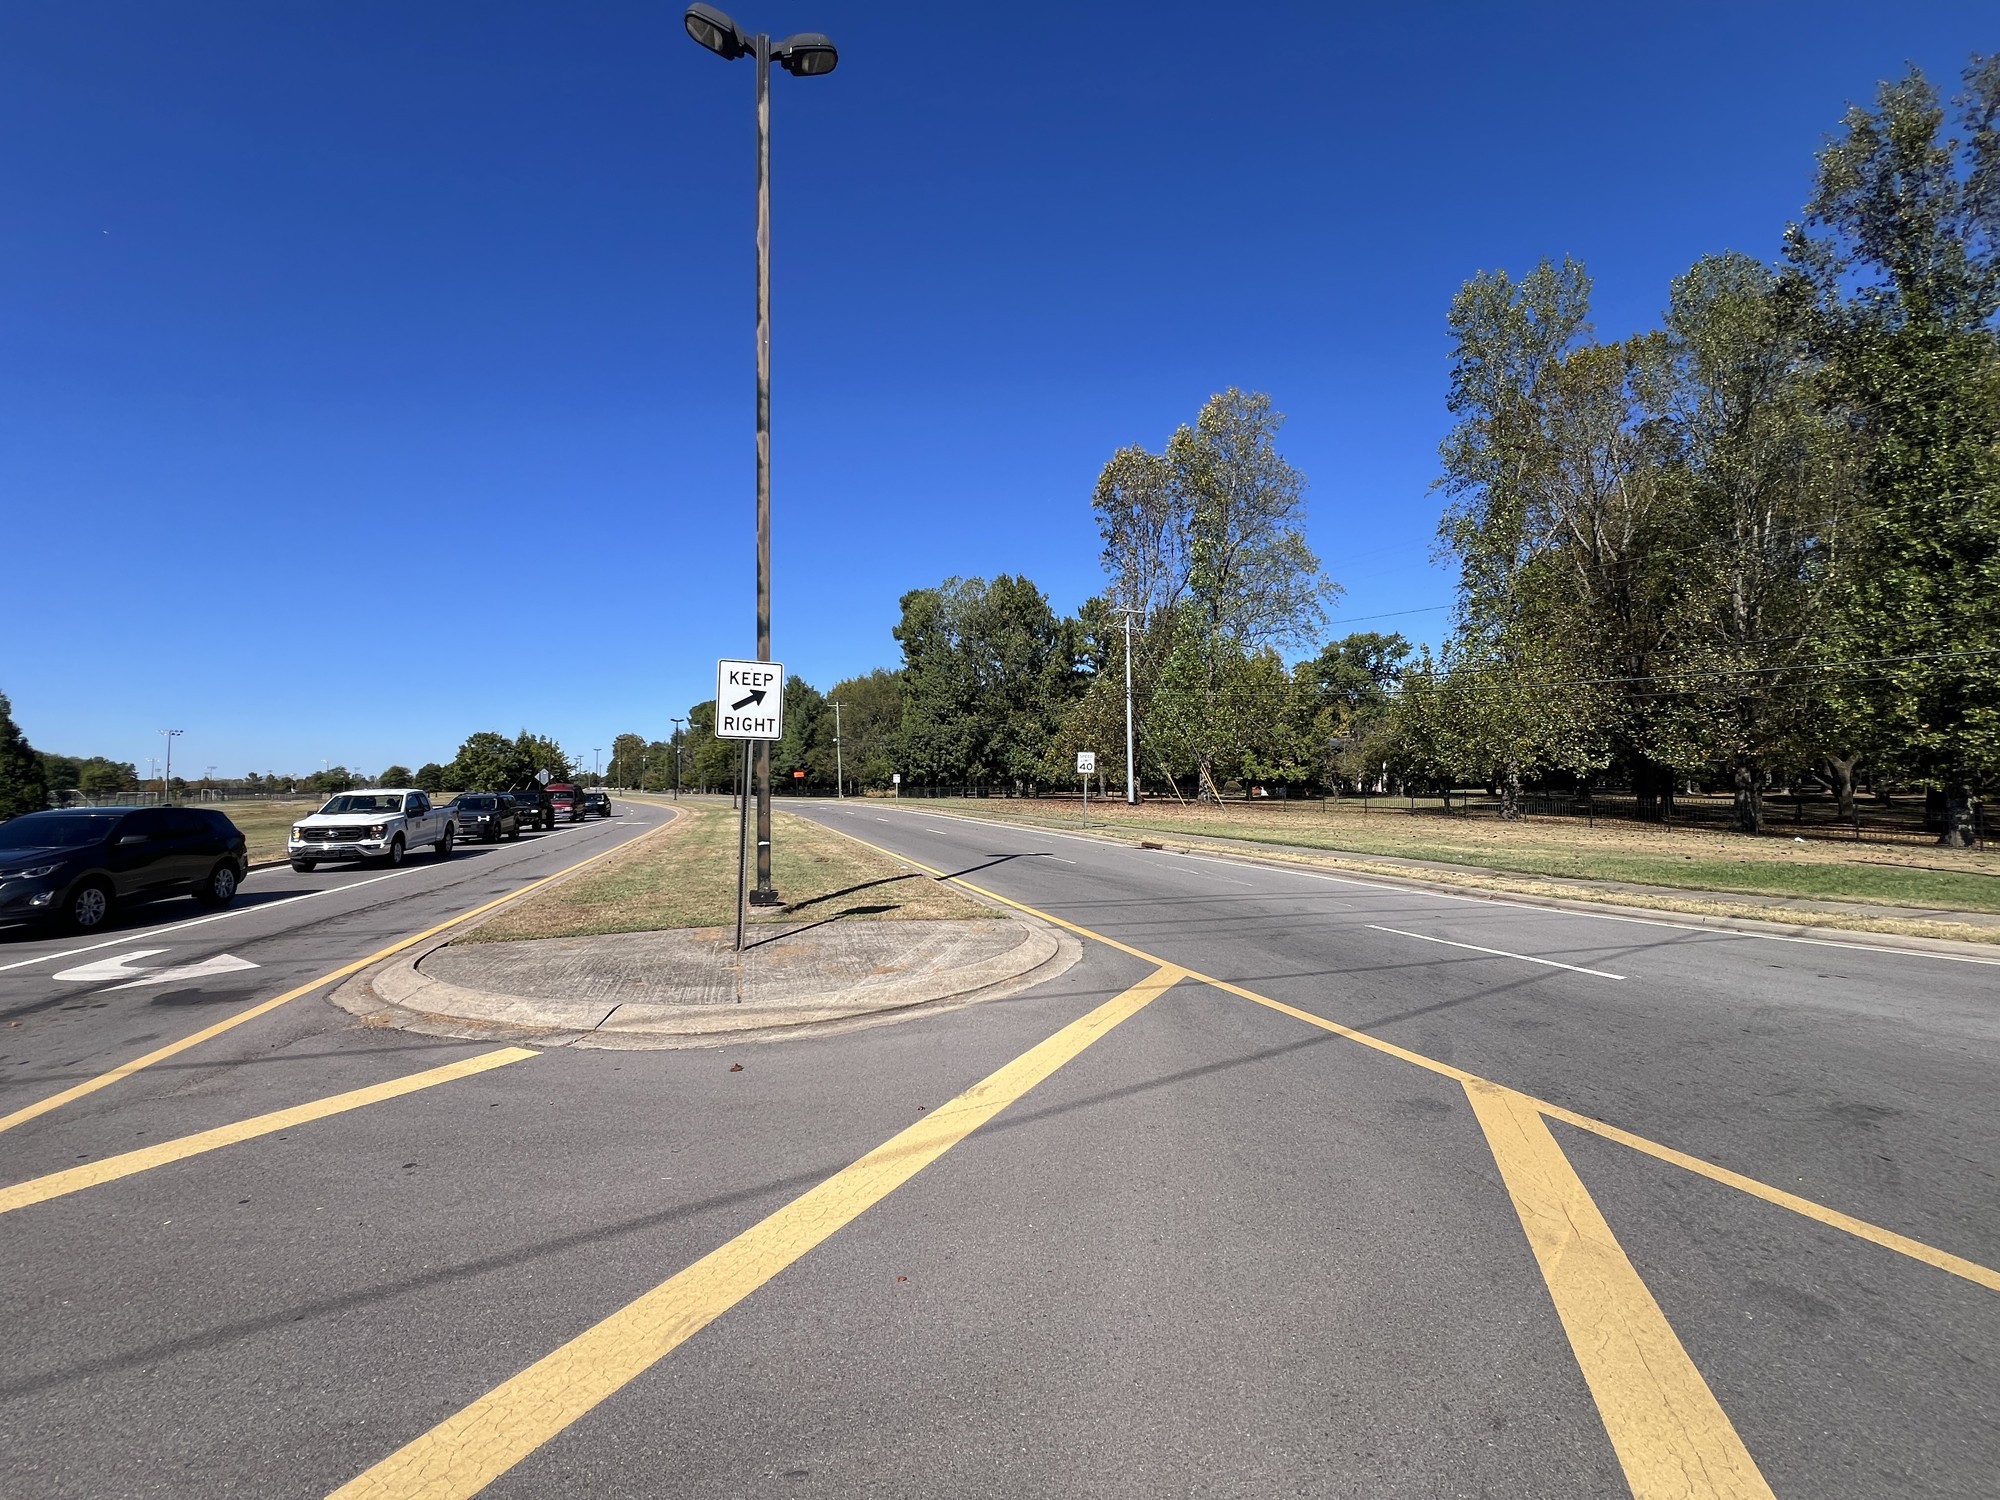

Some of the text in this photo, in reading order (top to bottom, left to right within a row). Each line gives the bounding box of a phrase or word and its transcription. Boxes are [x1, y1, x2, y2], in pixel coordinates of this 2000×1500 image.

[729, 671, 774, 687] KEEP
[724, 716, 776, 732] RIGHT
[1079, 762, 1093, 771] 40
